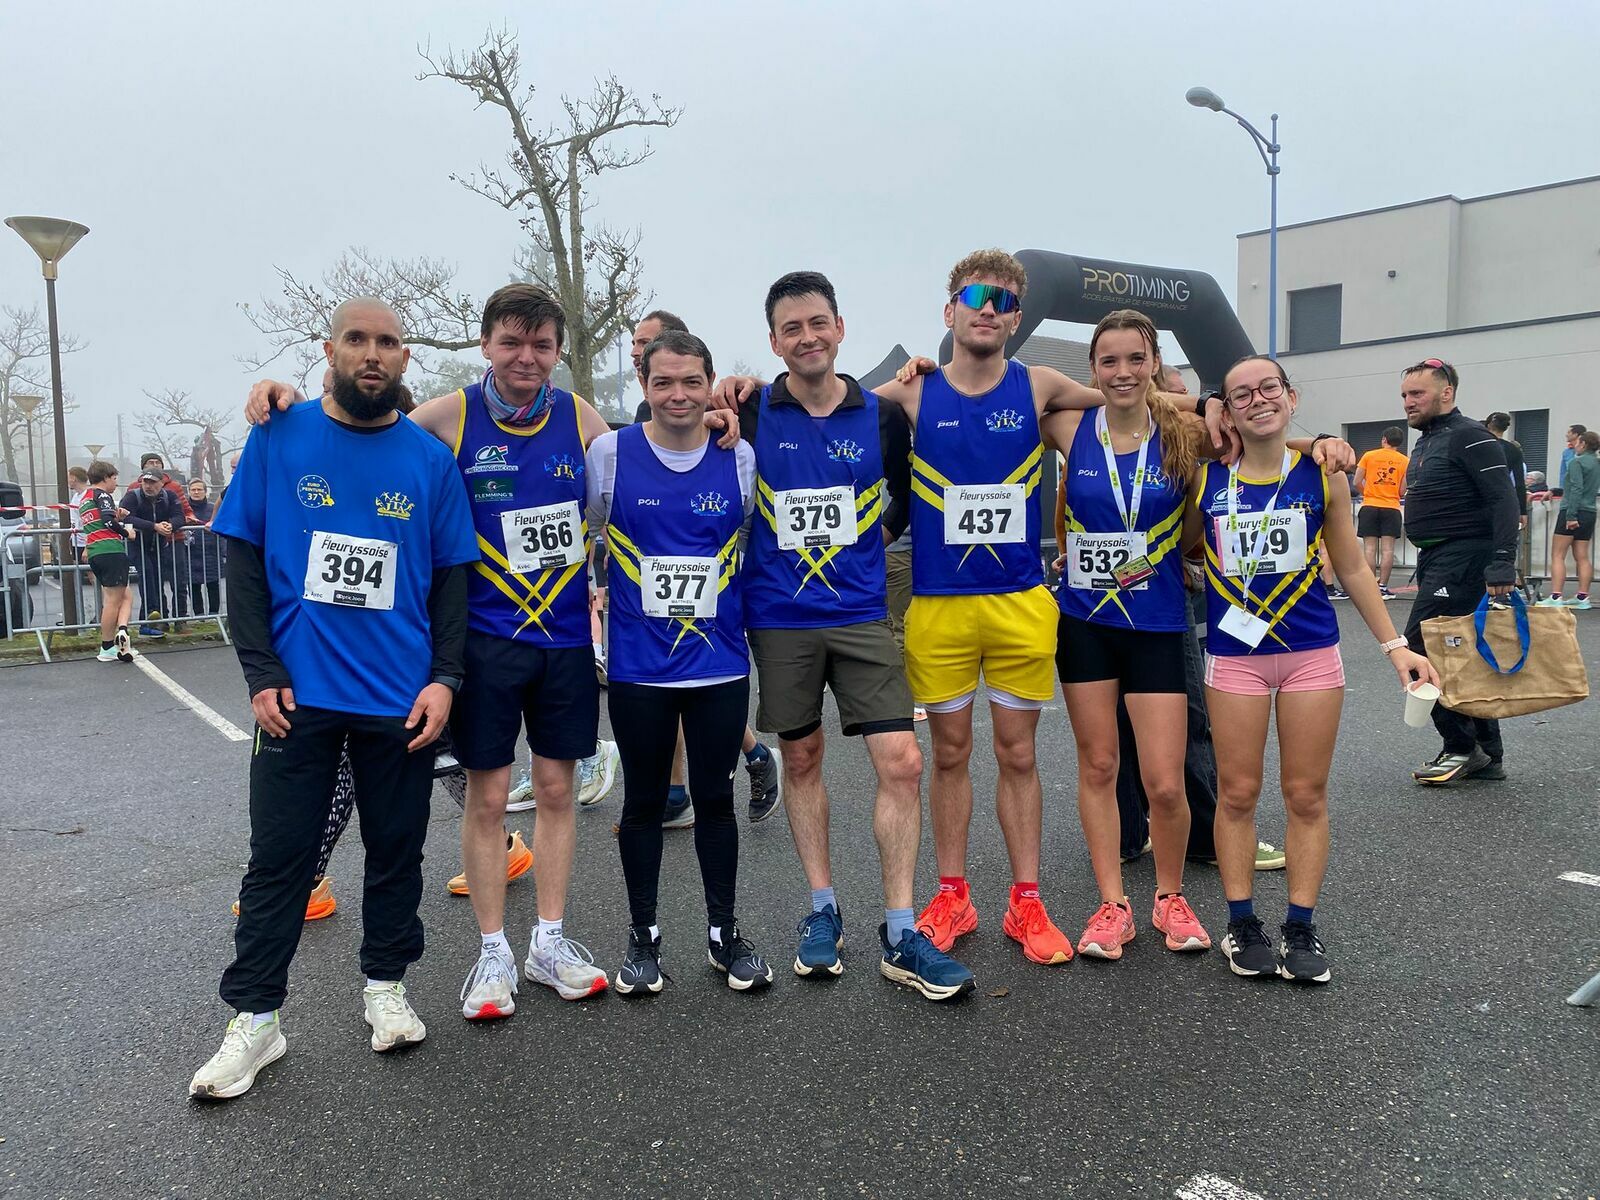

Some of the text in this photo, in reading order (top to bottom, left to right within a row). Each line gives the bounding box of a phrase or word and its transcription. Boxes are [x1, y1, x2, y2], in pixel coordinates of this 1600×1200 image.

[1082, 267, 1190, 302] PROTIMING
[779, 442, 798, 450] POLI
[553, 463, 576, 480] JTA
[1078, 469, 1099, 477] POLI
[307, 492, 318, 501] 37
[784, 492, 843, 506] Fleuryssoise
[959, 491, 1012, 502] Fleuryssoise
[699, 500, 721, 512] JTA
[514, 508, 571, 527] Fleuryssoise
[789, 504, 841, 532] 379
[958, 508, 1012, 534] 437
[1226, 515, 1292, 531] Furyoise
[521, 521, 573, 554] 366
[1231, 528, 1290, 558] 489
[321, 539, 389, 559] Fleuryssoise
[650, 561, 711, 574] Fleuryssoise
[1079, 549, 1130, 574] 532
[321, 553, 384, 589] 394
[343, 584, 361, 592] ALLAN
[655, 573, 707, 600] 377
